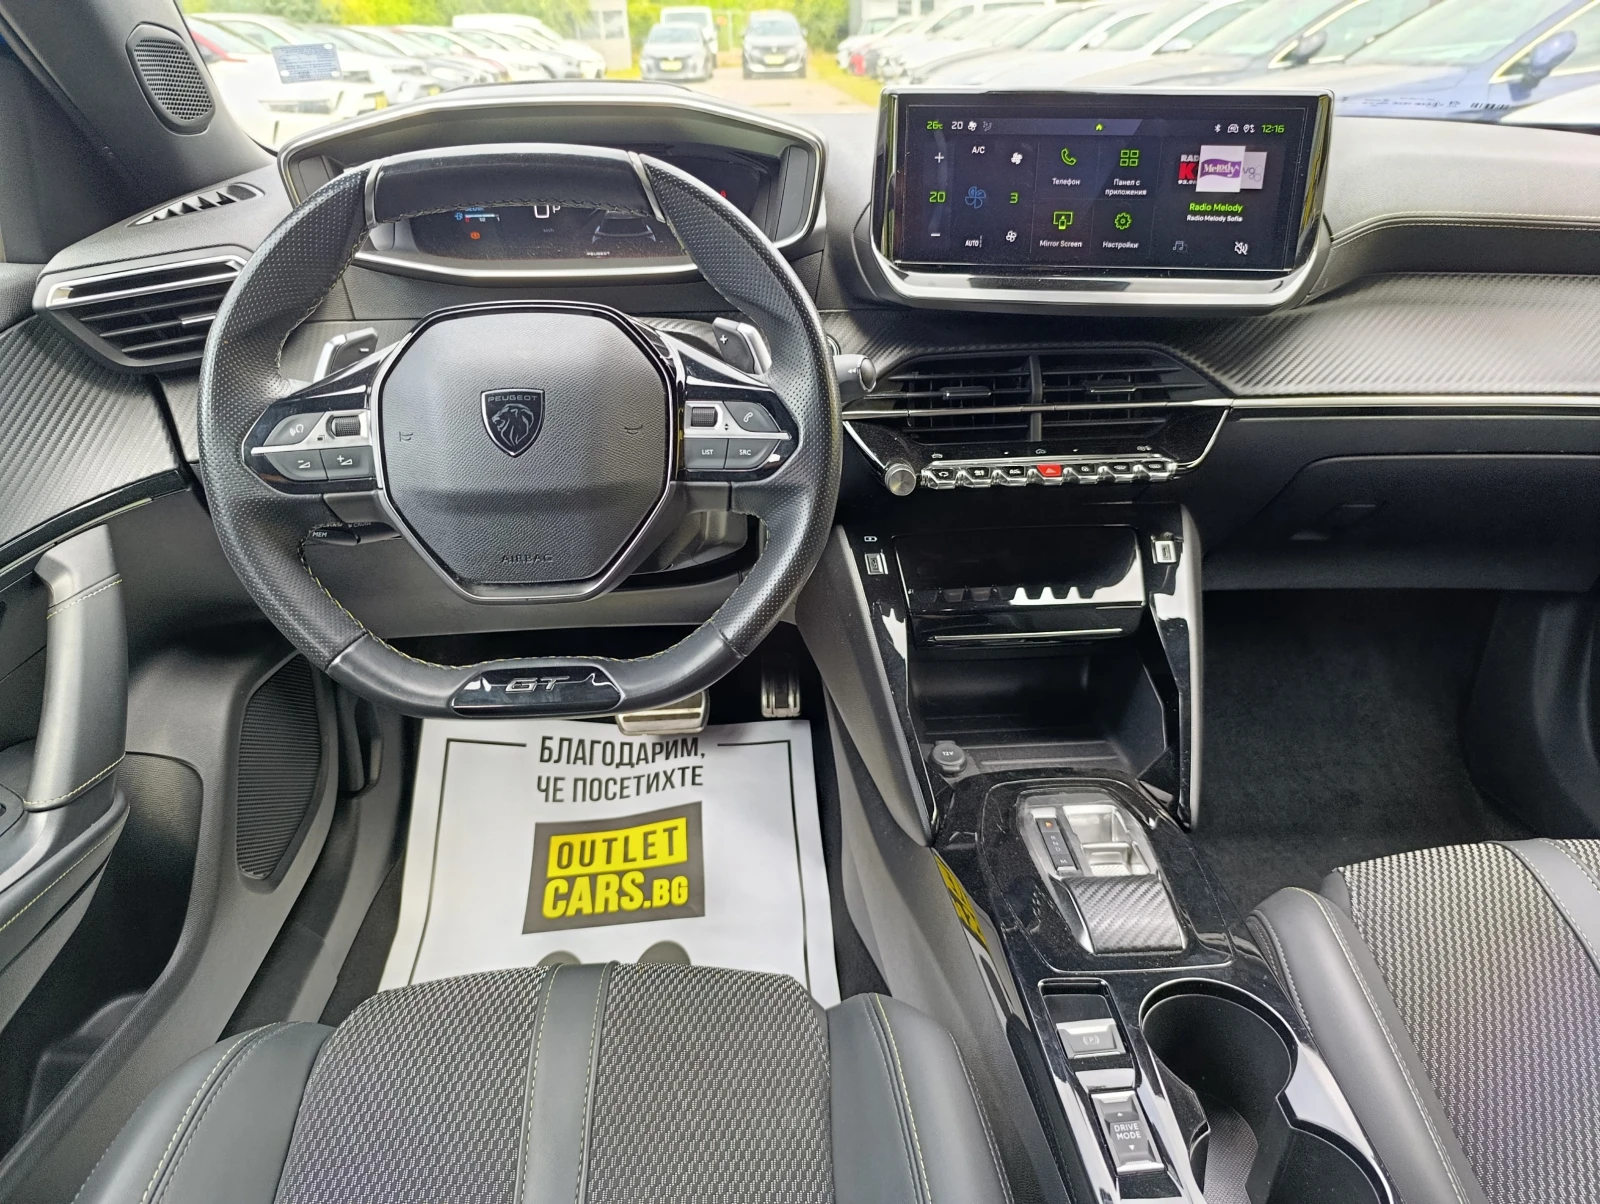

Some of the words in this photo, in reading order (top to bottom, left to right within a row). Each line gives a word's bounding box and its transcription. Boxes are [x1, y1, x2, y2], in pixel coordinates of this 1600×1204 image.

[951, 121, 964, 130] 20
[1261, 124, 1285, 133] 12:16
[971, 146, 986, 154] A/C
[1203, 162, 1237, 178] Melody
[1052, 177, 1081, 187] Телефон
[1113, 178, 1135, 186] Панел
[929, 191, 946, 203] 20
[1105, 189, 1147, 197] приложения
[1009, 192, 1019, 204] 3
[1189, 203, 1212, 212] Radio
[1213, 203, 1244, 214] Melody
[1186, 214, 1204, 222] Radio
[1204, 214, 1227, 223] Melody
[964, 239, 979, 247] AUTO
[1039, 240, 1060, 248] Mirror
[1060, 240, 1083, 248] Screen
[1102, 241, 1140, 250] Настройки
[487, 394, 538, 403] PEUGEOT
[501, 554, 554, 564] AIRBAG
[505, 675, 571, 693] GT
[539, 735, 706, 769] БЛАГОДАРИМ,
[536, 775, 567, 803] ЧЕ
[572, 765, 704, 803] ПОСЕТИХТЕ
[556, 825, 679, 870] OUTLET
[542, 870, 689, 919] CARS.BG
[1113, 1123, 1139, 1132] DRIVE
[1116, 1131, 1141, 1140] MODE
